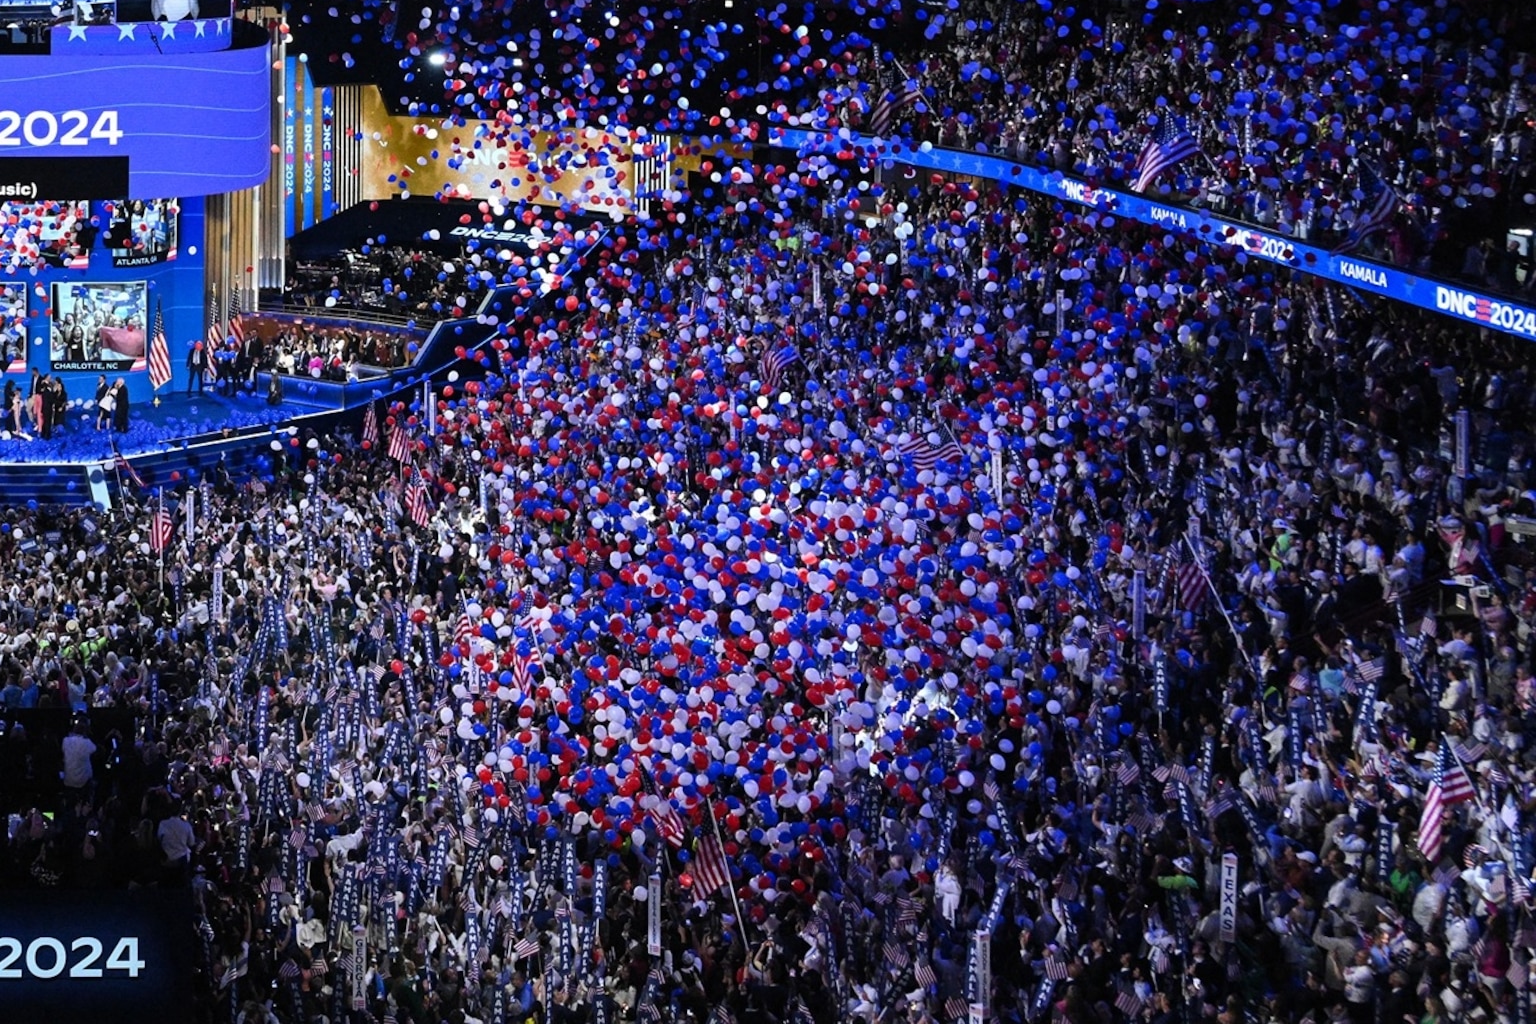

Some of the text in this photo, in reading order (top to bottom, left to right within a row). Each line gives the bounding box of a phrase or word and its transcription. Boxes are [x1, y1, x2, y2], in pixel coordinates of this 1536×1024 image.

[286, 125, 294, 195] DNC 2024
[304, 124, 313, 193] DNC 2024
[323, 161, 331, 192] 2024
[1340, 261, 1387, 288] KAMALA
[1436, 285, 1536, 336] DNC 2024
[53, 363, 105, 371] CHARLOTTE,
[368, 678, 376, 714] KAMALA
[1155, 661, 1164, 706] KAMALA
[1292, 712, 1300, 760] KAMALA
[238, 826, 246, 868] KAMALA
[434, 835, 445, 881] KAMALA
[566, 843, 574, 890] KAMALA
[1379, 829, 1390, 876] KAMALA
[340, 871, 354, 916] KAMALA
[594, 866, 604, 913] KAMALA
[1223, 866, 1235, 930] TEXAS
[355, 939, 364, 998] GEORGIA
[561, 922, 569, 971] KAMALA
[581, 926, 589, 974] KAMALA
[968, 947, 977, 1000] KAMALA
